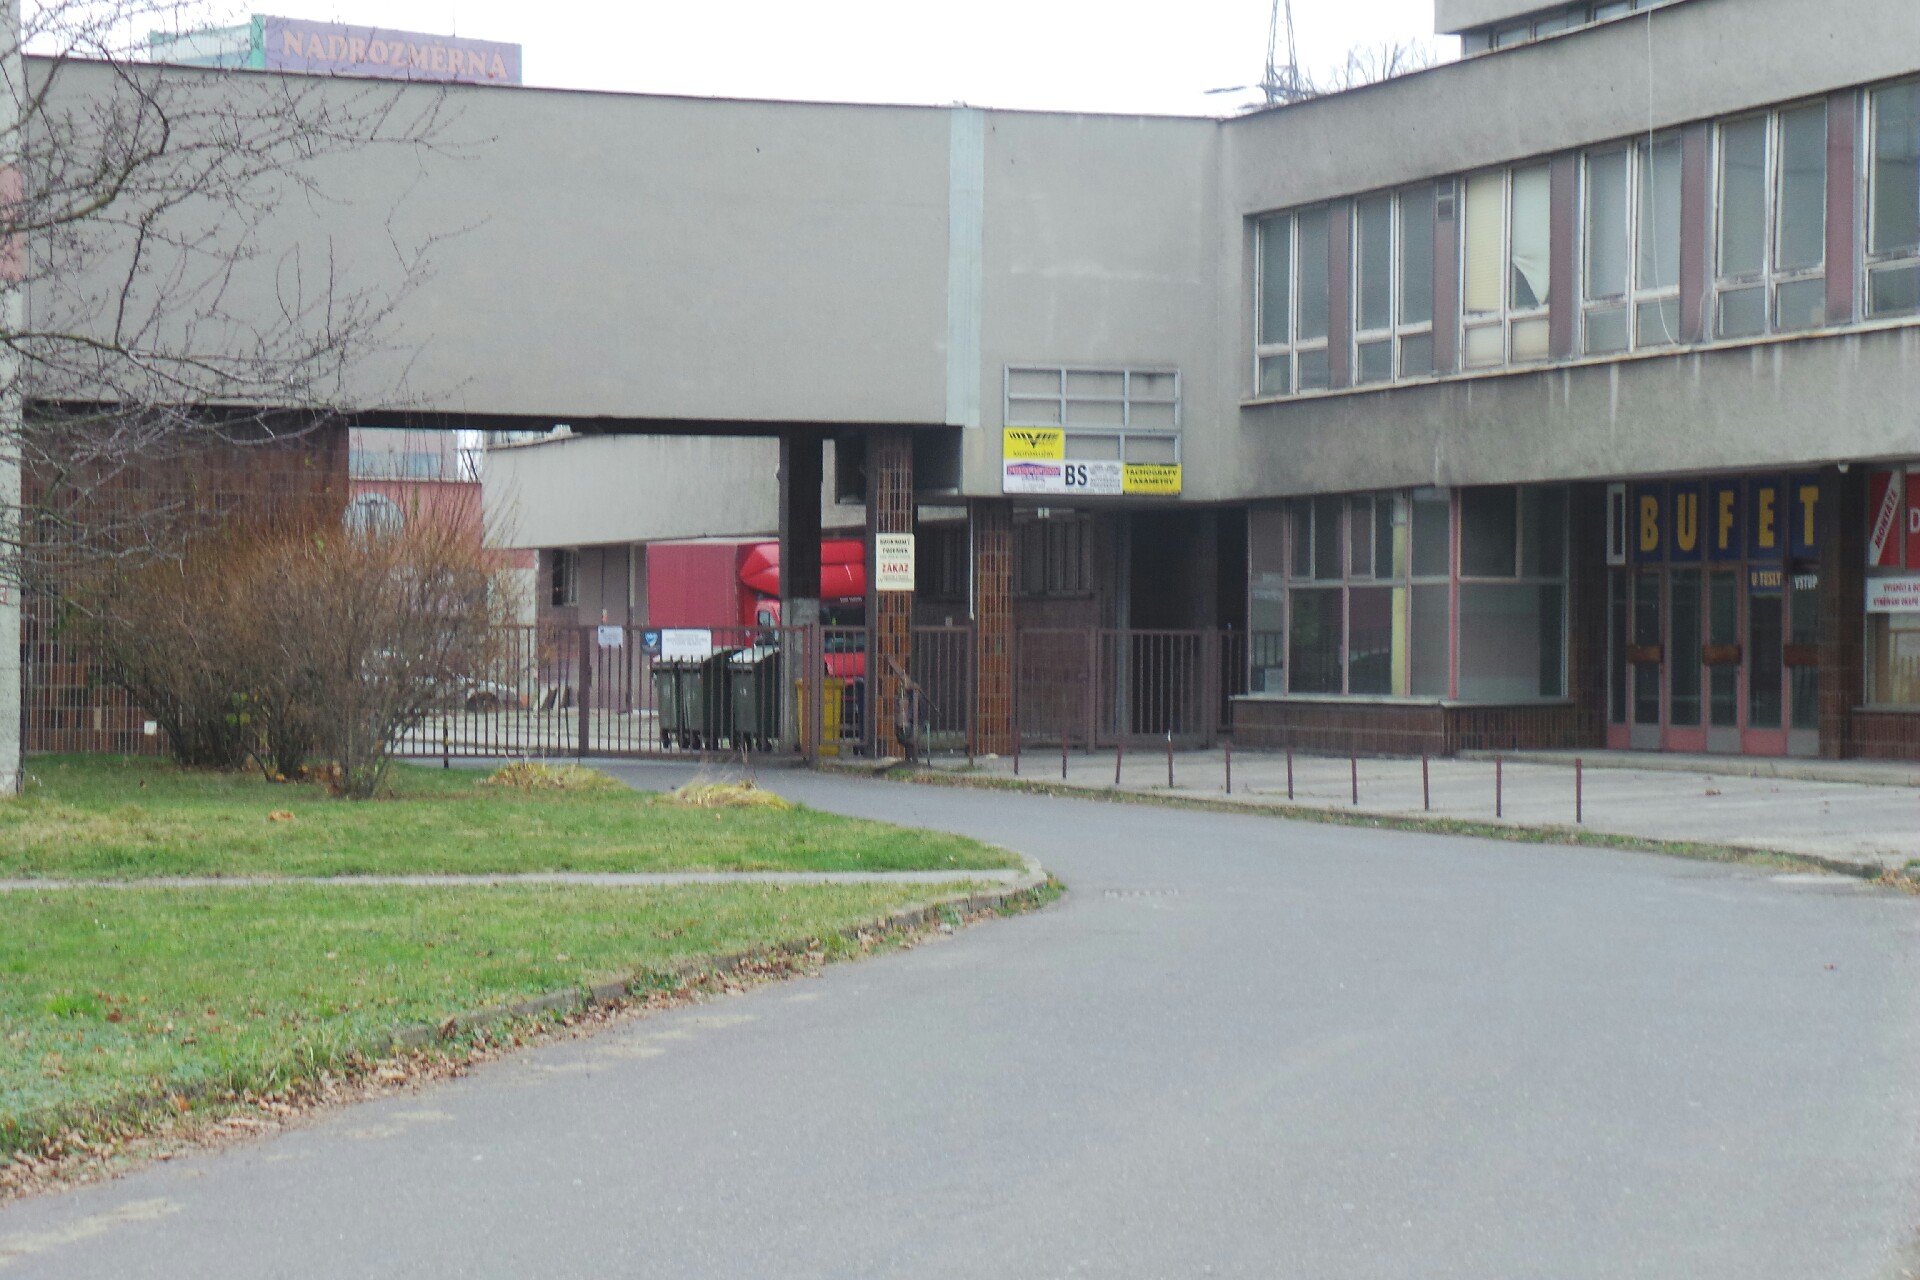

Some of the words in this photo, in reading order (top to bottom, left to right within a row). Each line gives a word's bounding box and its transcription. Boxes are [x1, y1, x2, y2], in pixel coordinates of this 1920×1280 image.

[1065, 465, 1087, 486] BS
[1640, 486, 1819, 552] BUFET
[1794, 574, 1818, 590] VSTUP
